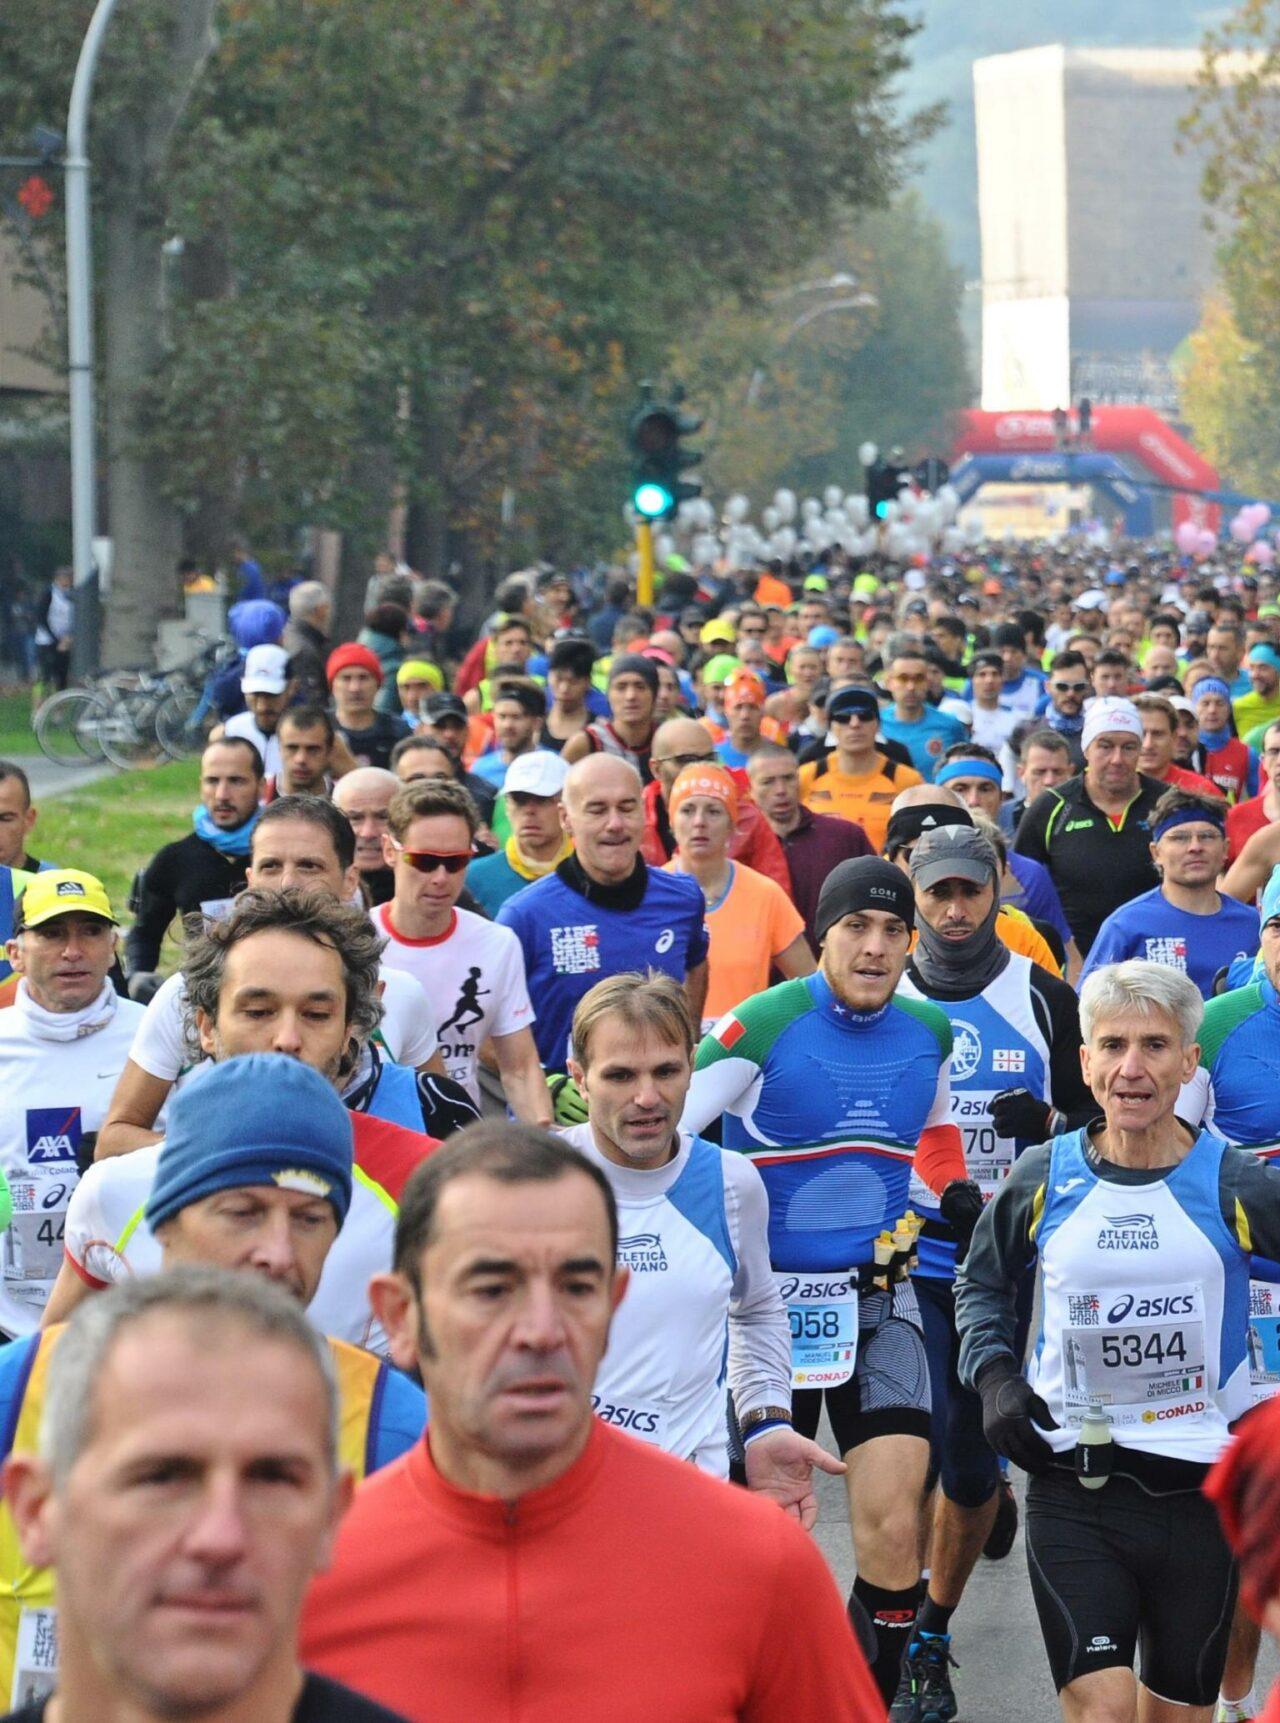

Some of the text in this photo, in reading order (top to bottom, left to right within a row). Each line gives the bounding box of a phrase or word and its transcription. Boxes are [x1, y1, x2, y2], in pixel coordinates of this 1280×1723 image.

[870, 887, 897, 898] GORE
[28, 1134, 77, 1160] AXA
[1099, 1230, 1159, 1240] ATLETICA
[1097, 1240, 1160, 1250] CAIVANO
[800, 1281, 850, 1298] asics
[1136, 1295, 1194, 1318] asics
[1102, 1331, 1187, 1368] 5344
[1147, 1386, 1182, 1398] DI MICCO
[1149, 1379, 1181, 1390] MICHELE
[598, 1404, 660, 1434] asics
[1157, 1401, 1205, 1421] CONAD
